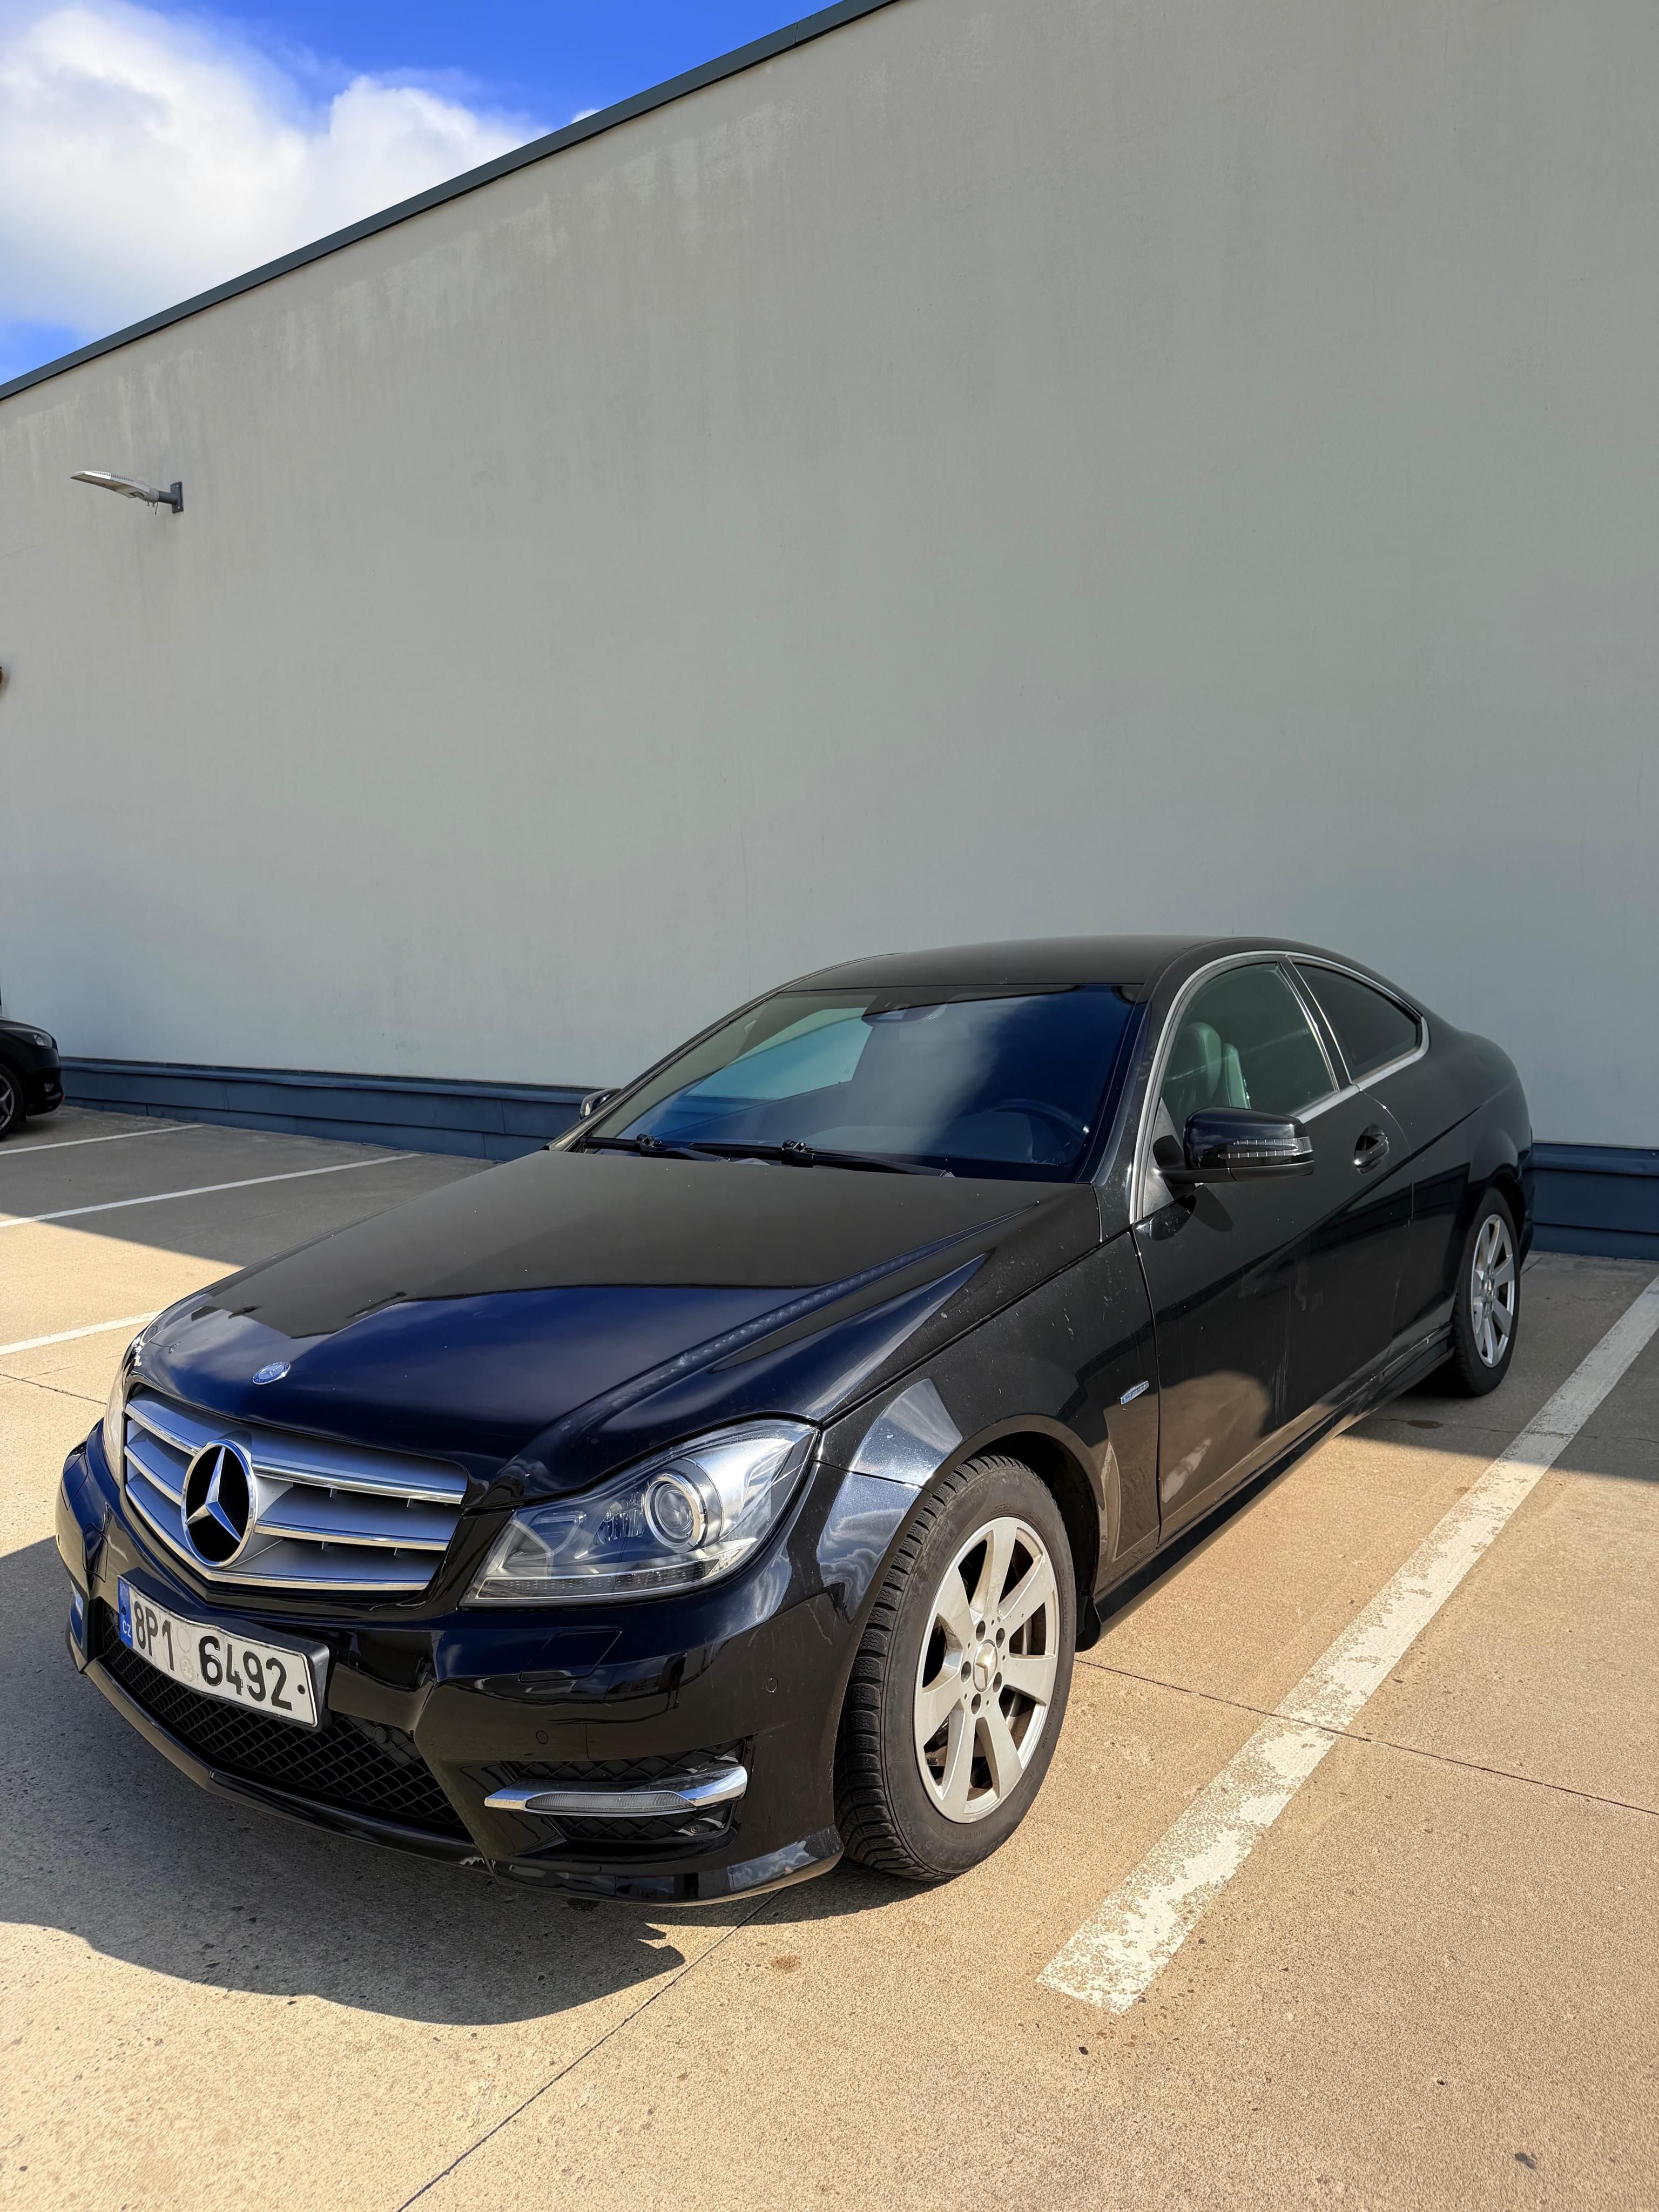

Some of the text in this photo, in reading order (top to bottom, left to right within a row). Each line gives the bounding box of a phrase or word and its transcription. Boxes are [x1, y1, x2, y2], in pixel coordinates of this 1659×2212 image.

[123, 1621, 132, 1638] CZ
[134, 1601, 292, 1711] 8P1 6492
